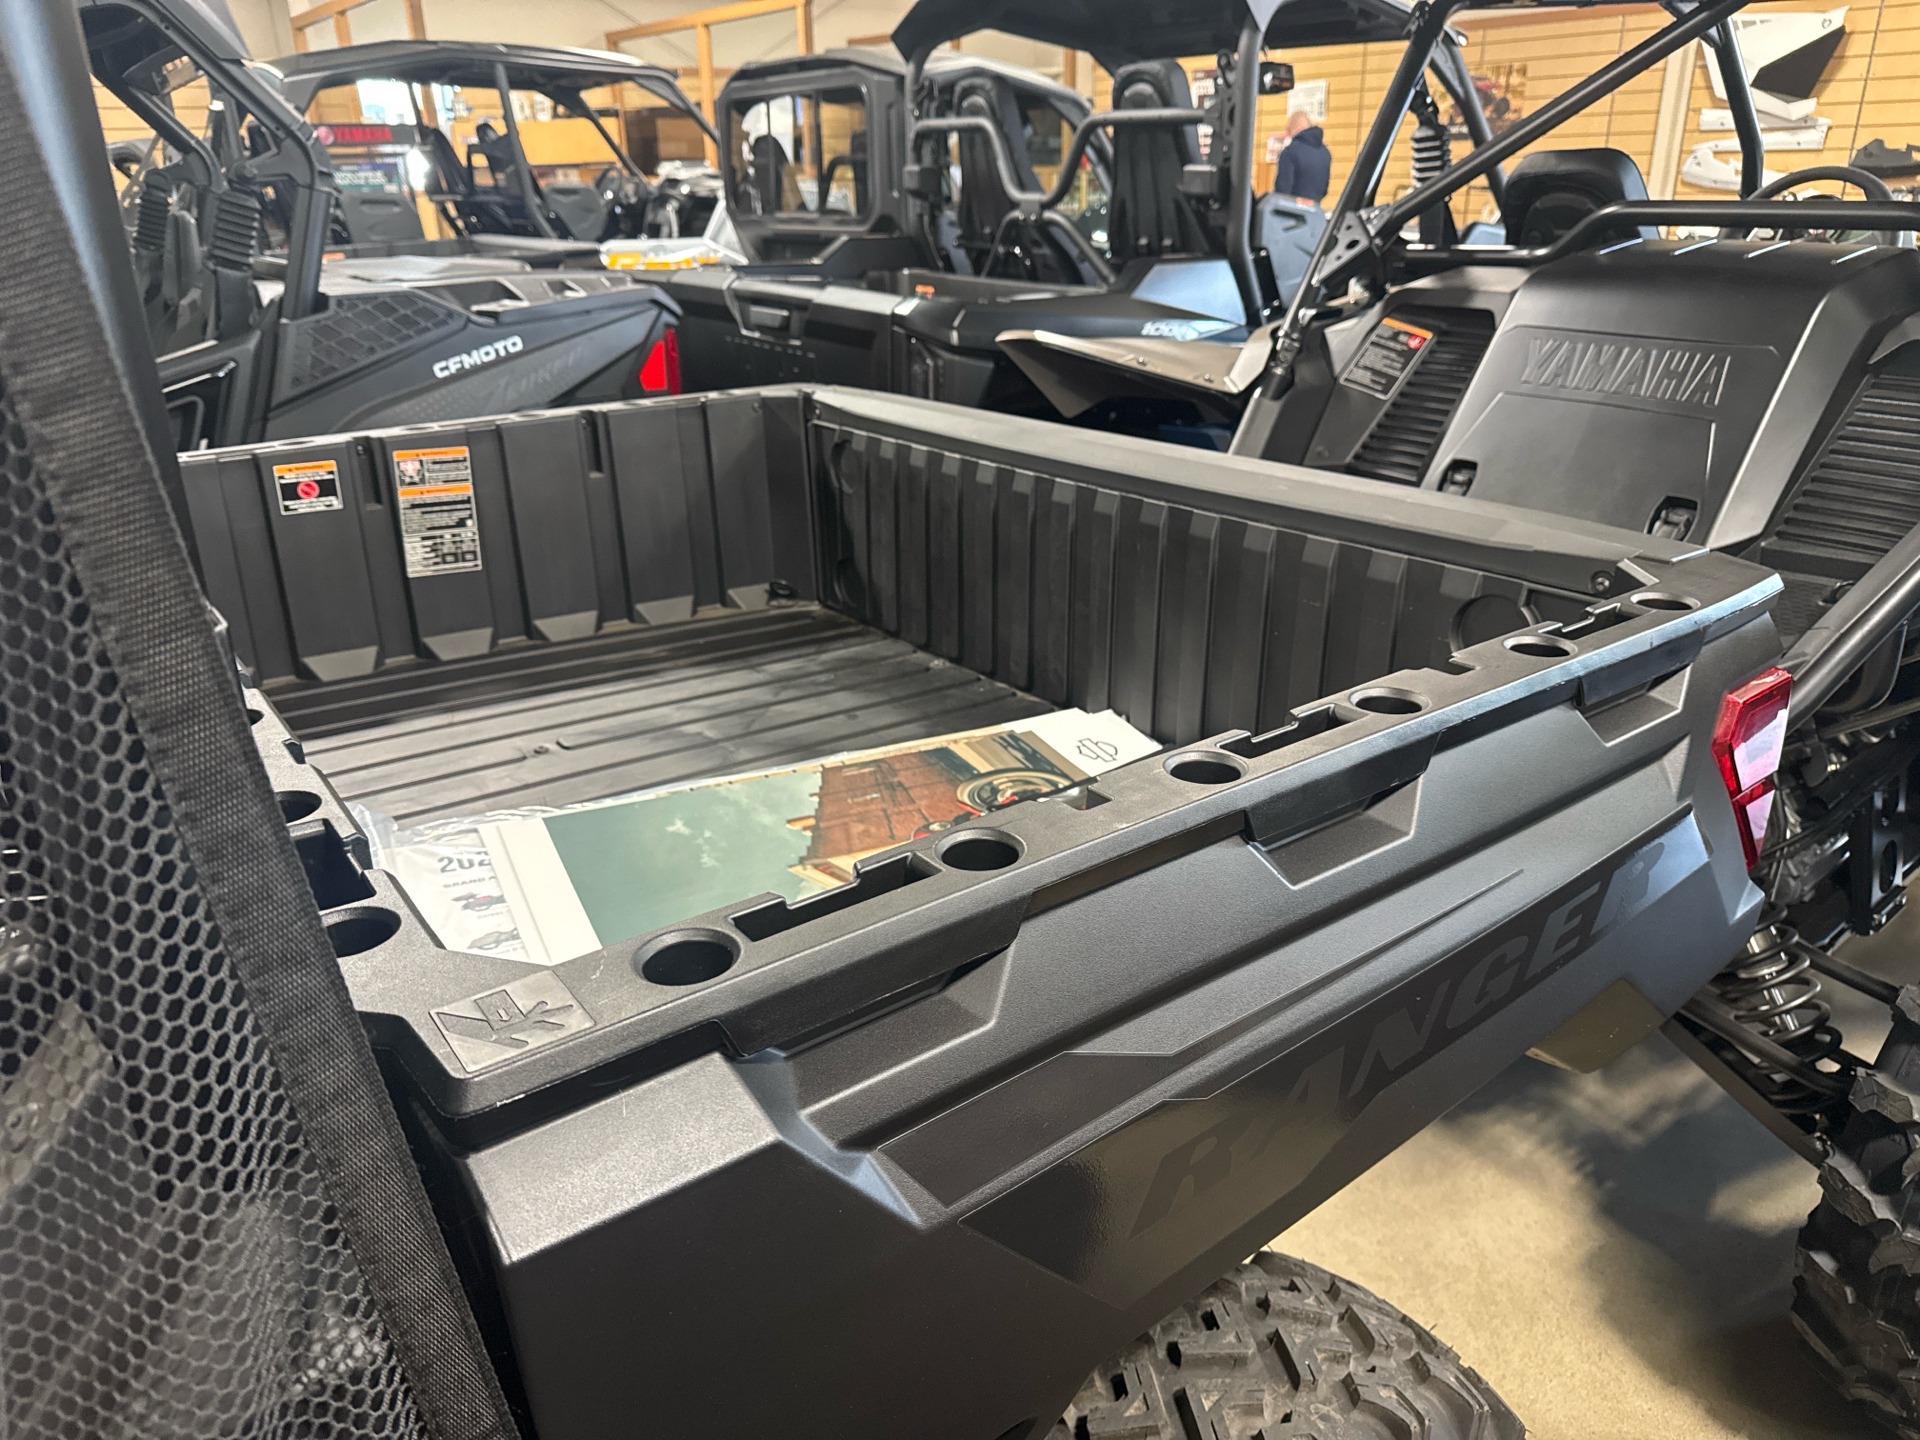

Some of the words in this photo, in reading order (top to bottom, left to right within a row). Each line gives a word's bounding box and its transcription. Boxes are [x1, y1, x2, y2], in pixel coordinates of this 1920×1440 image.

[333, 125, 393, 143] YAMAHA
[432, 335, 524, 379] CFMOTO
[1520, 338, 1732, 406] YAMAHA
[1129, 842, 1666, 1243] RANGER
